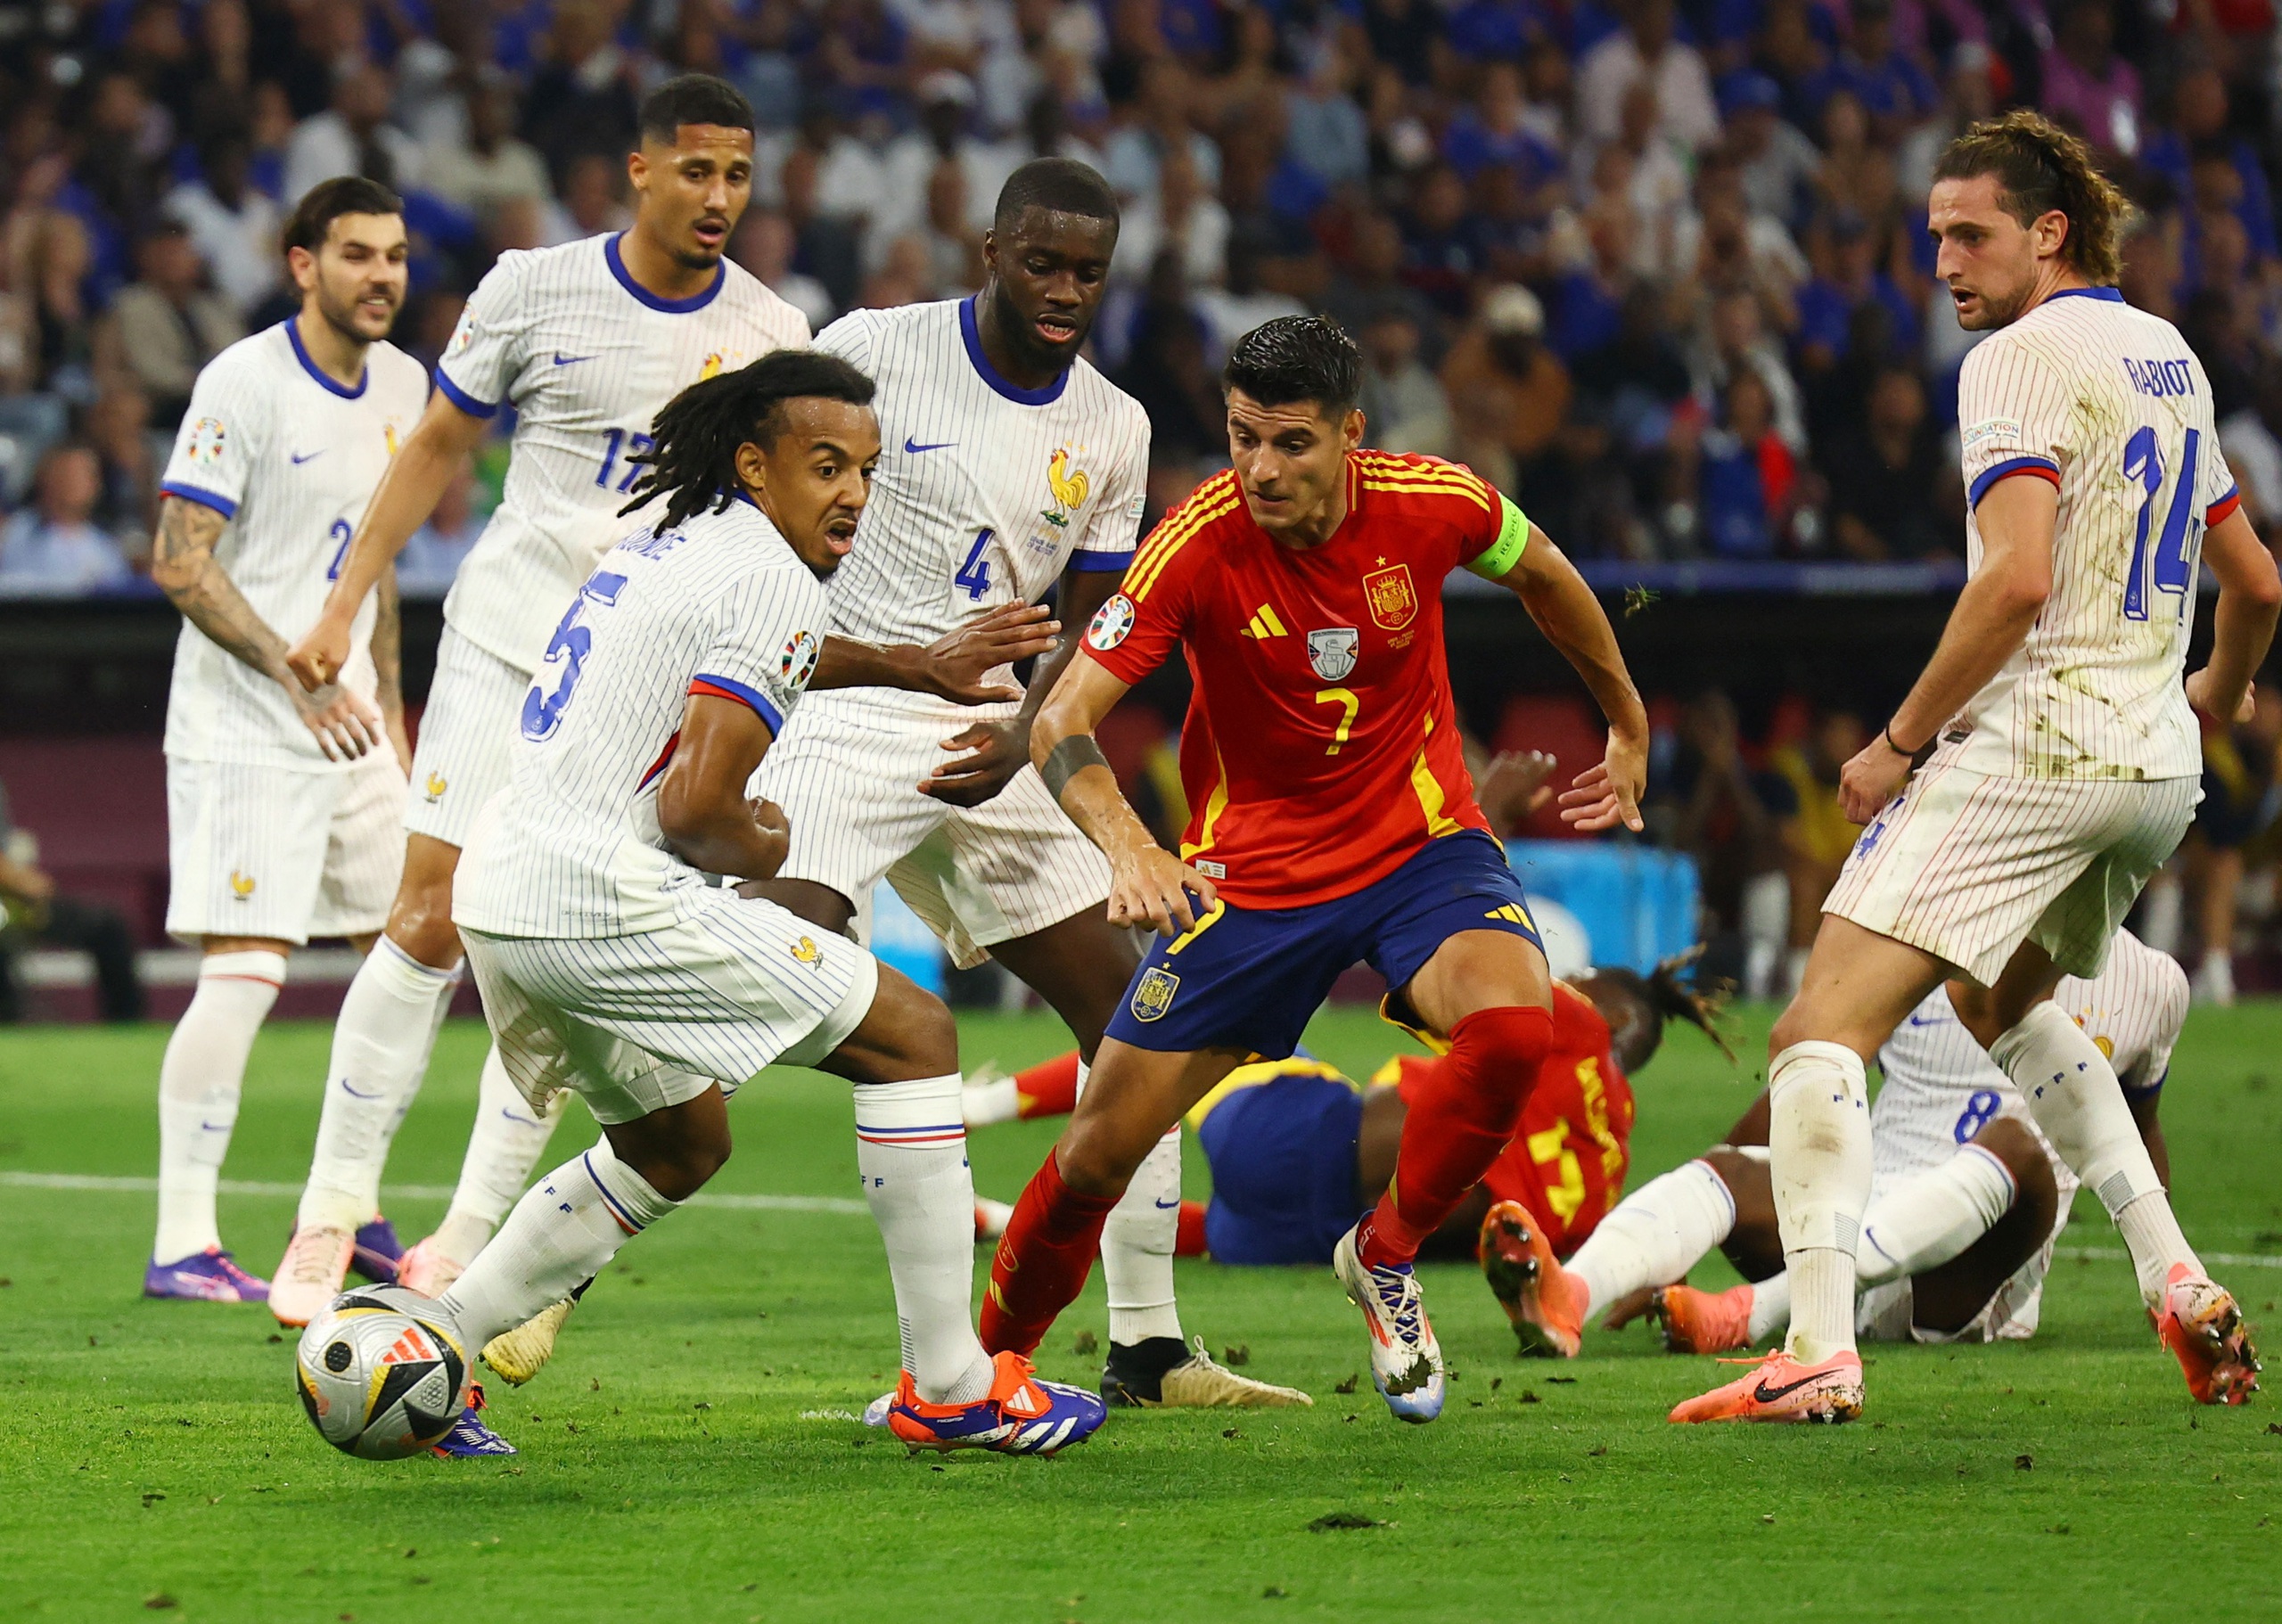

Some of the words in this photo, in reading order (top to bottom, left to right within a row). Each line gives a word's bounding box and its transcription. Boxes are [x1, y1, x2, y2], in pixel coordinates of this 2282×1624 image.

[2122, 357, 2196, 398] RABIOT
[595, 428, 656, 494] 17
[2123, 425, 2201, 626] 14
[955, 528, 996, 602] 4
[521, 570, 628, 742] 5
[1316, 687, 1359, 756] 7
[1954, 1089, 2001, 1144] 8
